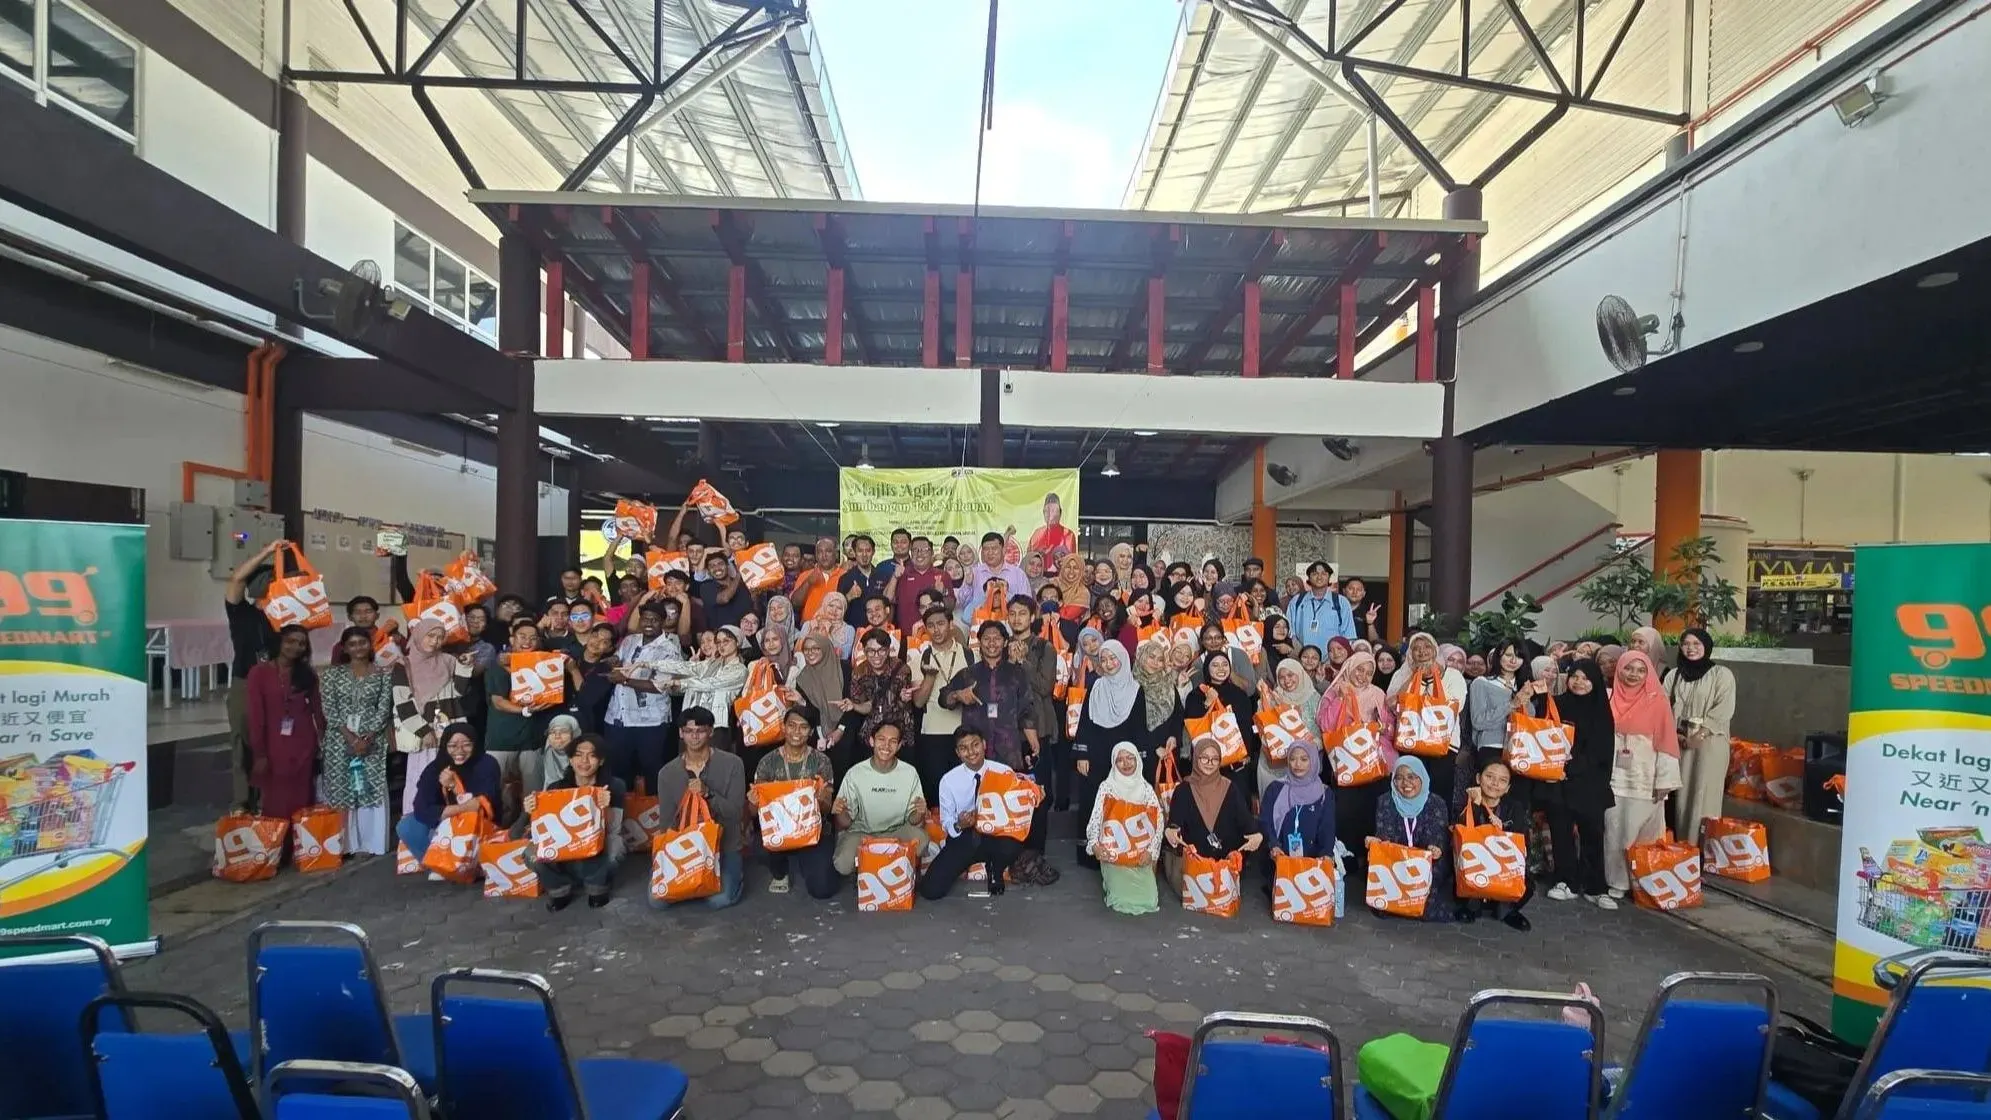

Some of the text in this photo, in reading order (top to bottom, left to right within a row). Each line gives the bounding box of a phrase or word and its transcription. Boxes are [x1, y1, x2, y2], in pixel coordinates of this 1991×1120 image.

[1896, 604, 1991, 669] 9
[12, 690, 46, 707] lagi
[53, 688, 110, 703] Murah
[511, 658, 564, 702] 99
[1888, 672, 1991, 696] SPEED
[49, 728, 94, 742] Save
[1509, 727, 1571, 771] 99
[1882, 743, 1947, 763] Dekat
[759, 785, 821, 847] 99
[1899, 790, 1962, 812] Near
[531, 795, 602, 860] 99
[1459, 835, 1525, 888] 99
[1273, 867, 1335, 921] 99
[1366, 858, 1432, 910] 99
